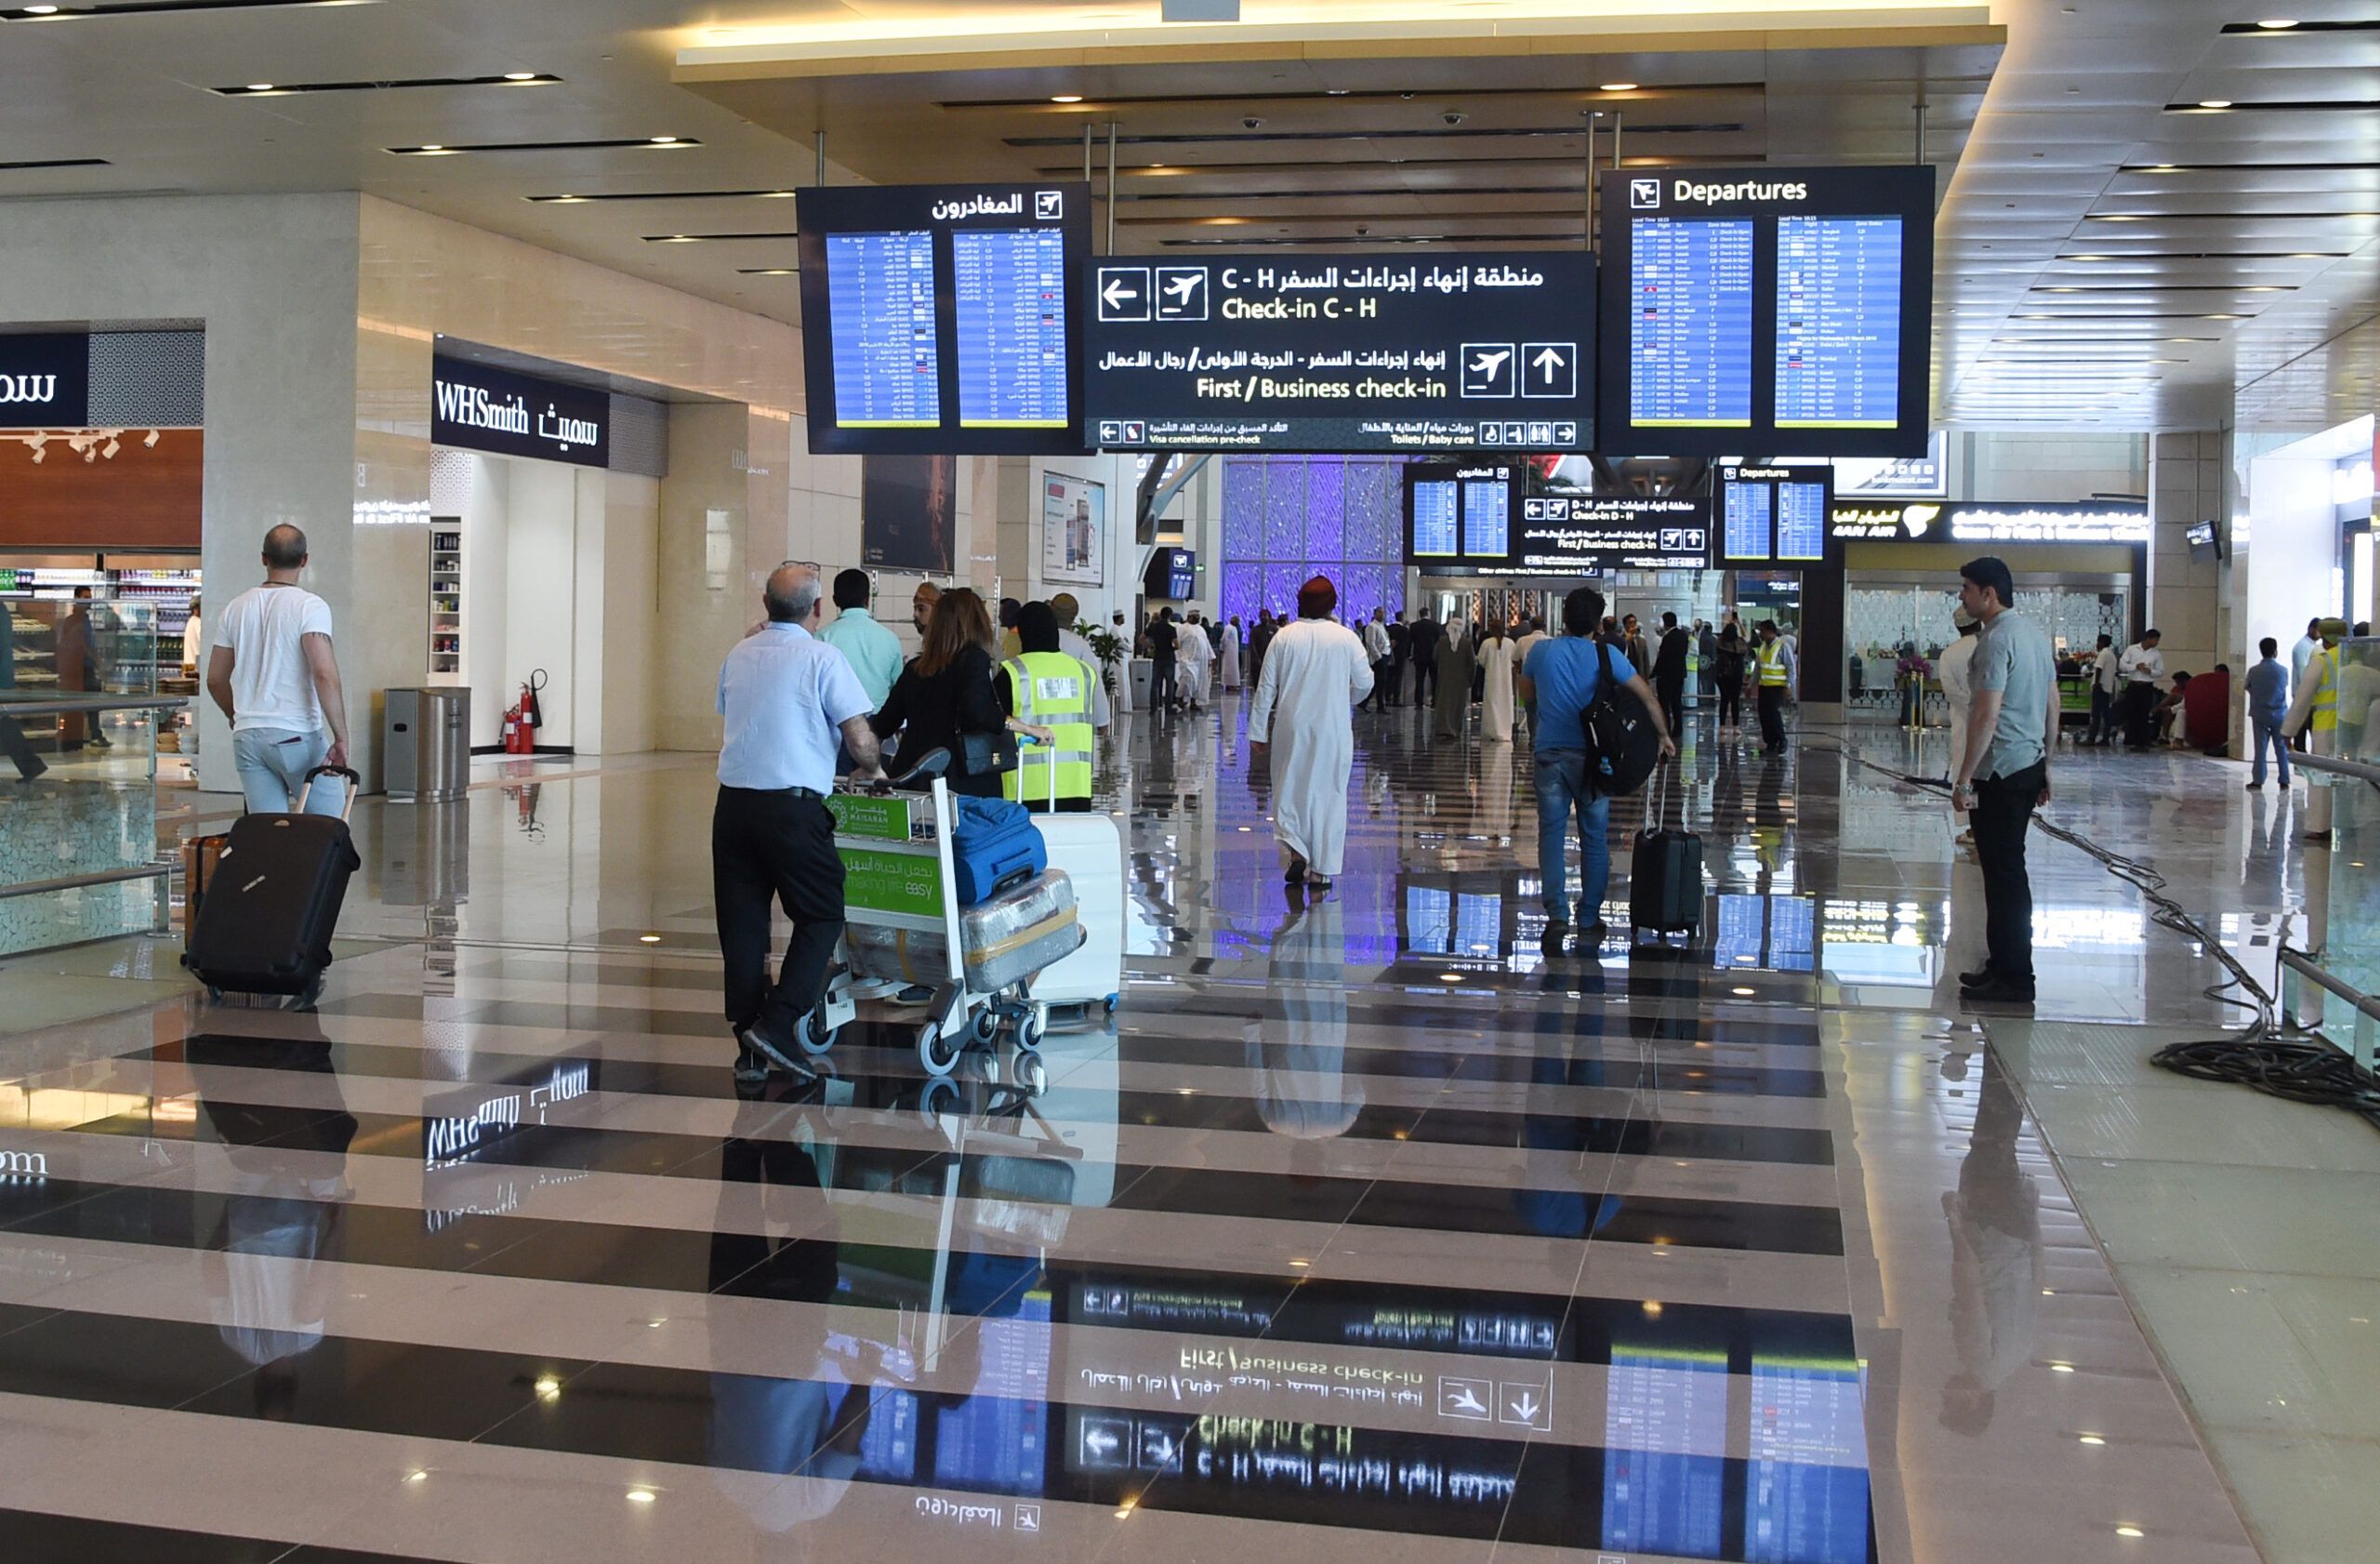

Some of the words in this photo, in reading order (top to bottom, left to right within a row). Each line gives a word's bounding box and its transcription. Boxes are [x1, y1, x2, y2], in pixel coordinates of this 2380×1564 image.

[1673, 179, 1806, 205] Departures
[932, 193, 1024, 221] المغادرون
[1222, 268, 1237, 289] C
[1258, 268, 1274, 289] H
[1278, 267, 1338, 293] السفر
[1343, 267, 1417, 293] إجراءات
[1422, 266, 1469, 293] إنهاء
[1474, 265, 1544, 286] منطقة
[1222, 297, 1316, 319] Check-in
[1323, 297, 1339, 319] C
[1359, 297, 1377, 318] H
[1099, 350, 1152, 370] الأعمال
[1250, 351, 1293, 370] الدرجة
[1307, 350, 1352, 370] السفر
[1355, 350, 1408, 371] إجراءات
[1413, 350, 1446, 371] إنهاء
[1197, 378, 1242, 398] First
[1261, 377, 1350, 398] Business
[1355, 377, 1447, 398] check-in
[435, 379, 530, 435] WHSmith
[538, 403, 598, 452] سميث
[1224, 425, 1236, 433] من
[1237, 423, 1267, 434] المسبق
[1448, 422, 1474, 433] دورات
[1149, 434, 1167, 444] Visa
[1168, 434, 1218, 444] cancellation
[1220, 434, 1261, 445] pre-check
[1391, 434, 1421, 444] Toilets
[1428, 434, 1452, 446] Baby
[1456, 468, 1494, 478] المغادرون
[1739, 468, 1790, 478] Departures
[1572, 500, 1580, 509] D
[1585, 500, 1593, 509] H
[1572, 511, 1610, 521] Check-in
[1611, 511, 1620, 521] D
[1626, 511, 1634, 521] H
[1868, 525, 1897, 537] AIR
[1992, 524, 2012, 539] Air
[2012, 525, 2043, 539] First
[1557, 539, 1577, 549] First
[1583, 539, 1619, 549] Business
[1620, 539, 1657, 550] check-in
[905, 881, 933, 901] easy
